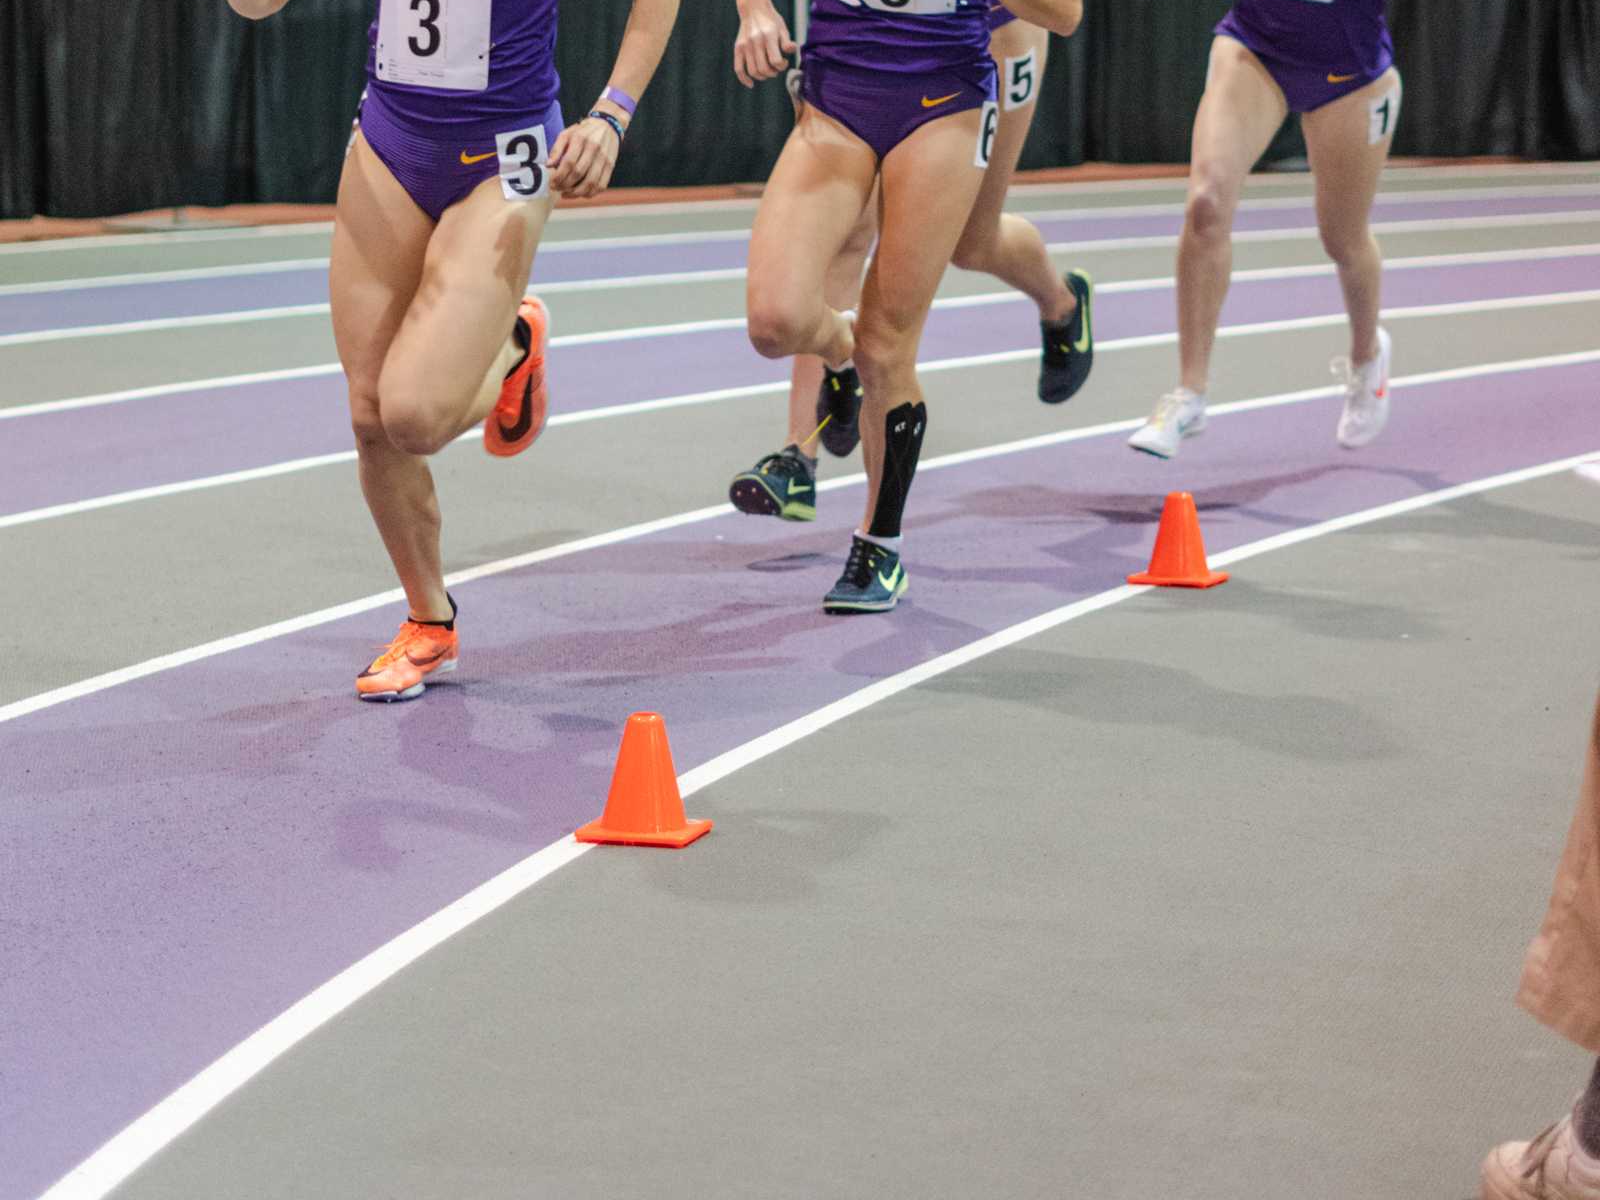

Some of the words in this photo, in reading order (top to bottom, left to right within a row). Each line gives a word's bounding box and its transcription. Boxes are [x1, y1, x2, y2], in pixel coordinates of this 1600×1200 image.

[1010, 56, 1032, 104] 5
[1375, 97, 1389, 134] 1
[504, 133, 543, 196] 3
